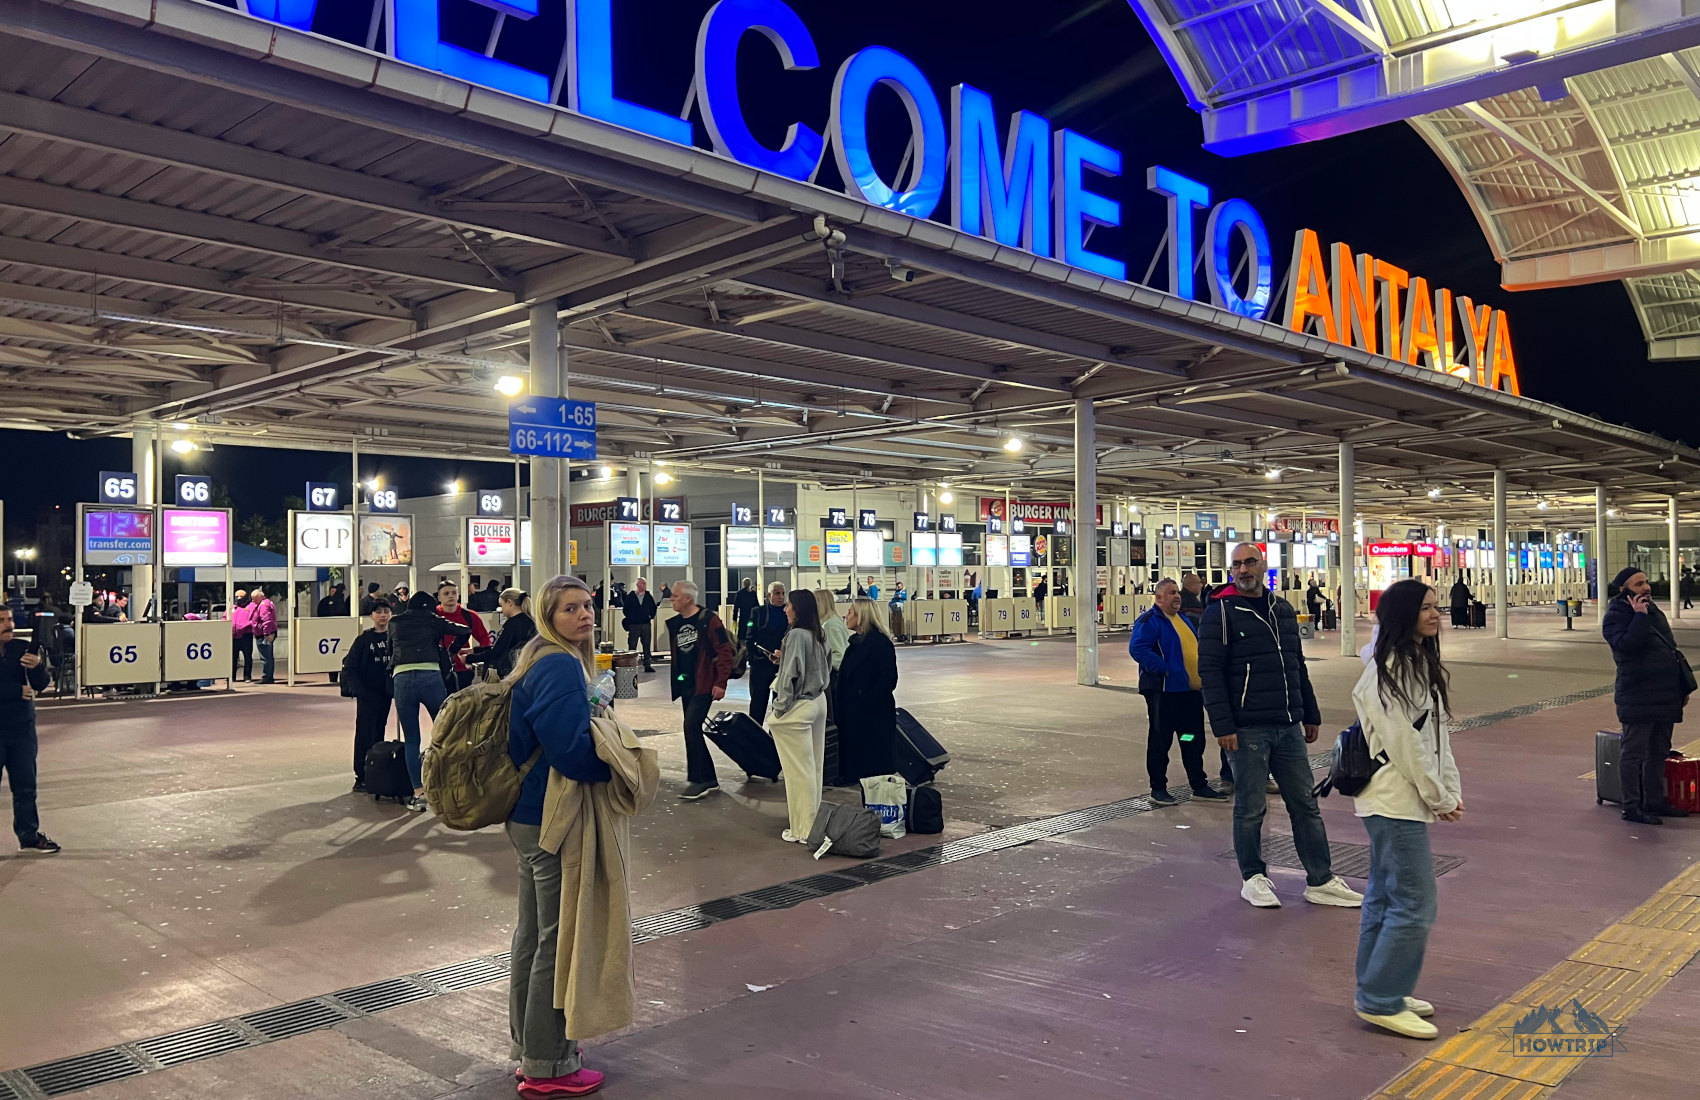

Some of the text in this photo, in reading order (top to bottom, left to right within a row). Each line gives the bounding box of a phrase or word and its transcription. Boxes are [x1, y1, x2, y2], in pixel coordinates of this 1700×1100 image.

[237, 0, 1521, 396] ELCOME TO ANTALYA
[558, 403, 594, 427] 1-65
[515, 428, 573, 453] 66-112
[104, 477, 135, 498] 65
[181, 481, 209, 501] 66
[311, 487, 336, 506] 67
[373, 490, 397, 508] 68
[481, 494, 502, 512] 69
[621, 501, 638, 517] 71
[662, 503, 680, 519] 72
[736, 507, 751, 522] 73
[770, 509, 785, 522] 74
[1010, 503, 1052, 519] BURGER
[93, 513, 149, 537] 724
[832, 511, 845, 525] 75
[862, 513, 875, 526] 76
[916, 515, 928, 528] 77
[943, 516, 954, 529] 78
[991, 518, 1001, 530] 79
[1287, 519, 1327, 531] BURGER KING
[473, 525, 511, 537] BUCHER
[1056, 521, 1066, 532] 81
[1113, 523, 1123, 535] 83
[89, 539, 151, 549] transfer.com
[300, 528, 350, 550] CIP
[1380, 545, 1408, 553] vodafone
[950, 611, 961, 622] 78
[998, 610, 1007, 620] 79
[1021, 608, 1030, 619] 80
[1062, 607, 1071, 617] 81
[1120, 604, 1129, 615] 83
[924, 612, 935, 624] 77
[185, 642, 213, 661] 66
[318, 638, 341, 655] 67
[108, 644, 138, 664] 65
